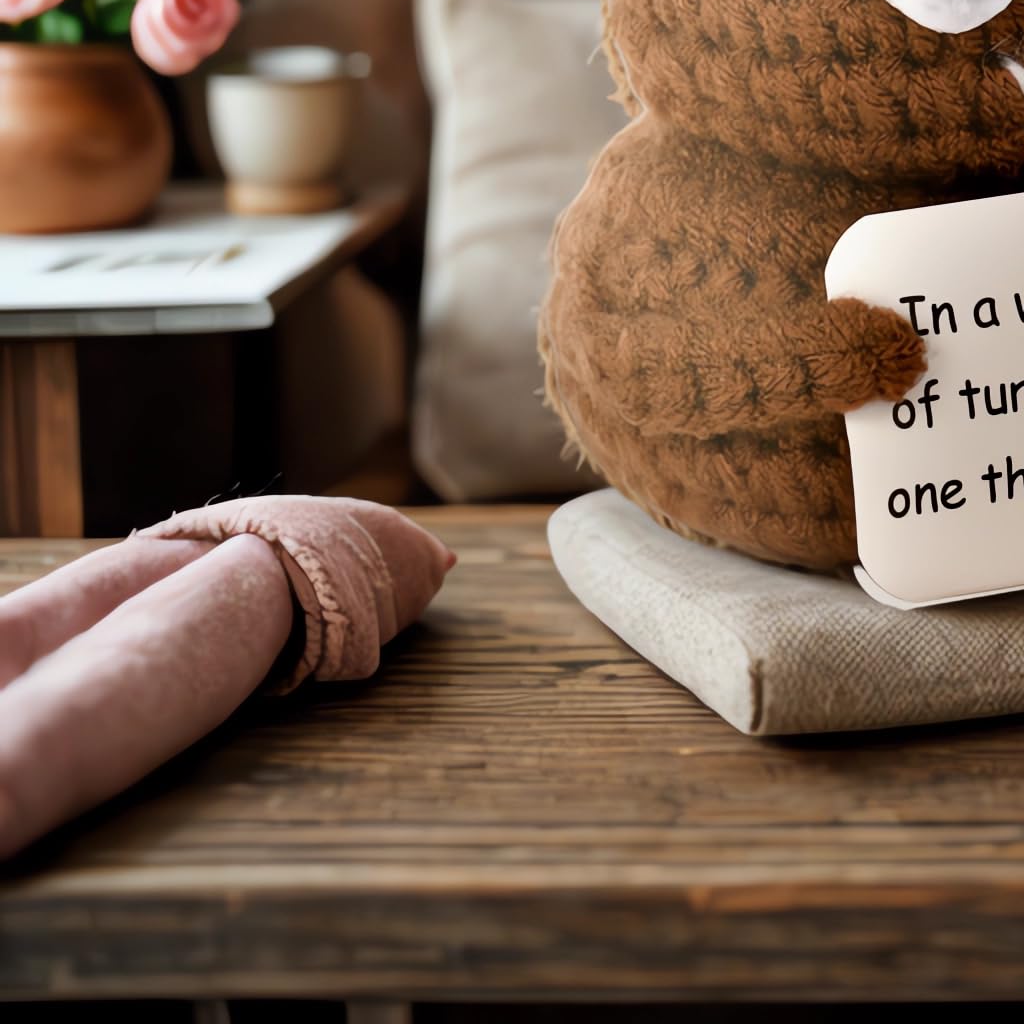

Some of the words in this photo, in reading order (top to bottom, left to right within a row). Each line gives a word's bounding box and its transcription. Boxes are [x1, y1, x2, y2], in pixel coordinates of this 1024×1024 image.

[899, 295, 958, 336] In
[973, 297, 1001, 329] a
[892, 378, 940, 430] of
[887, 479, 967, 519] one
